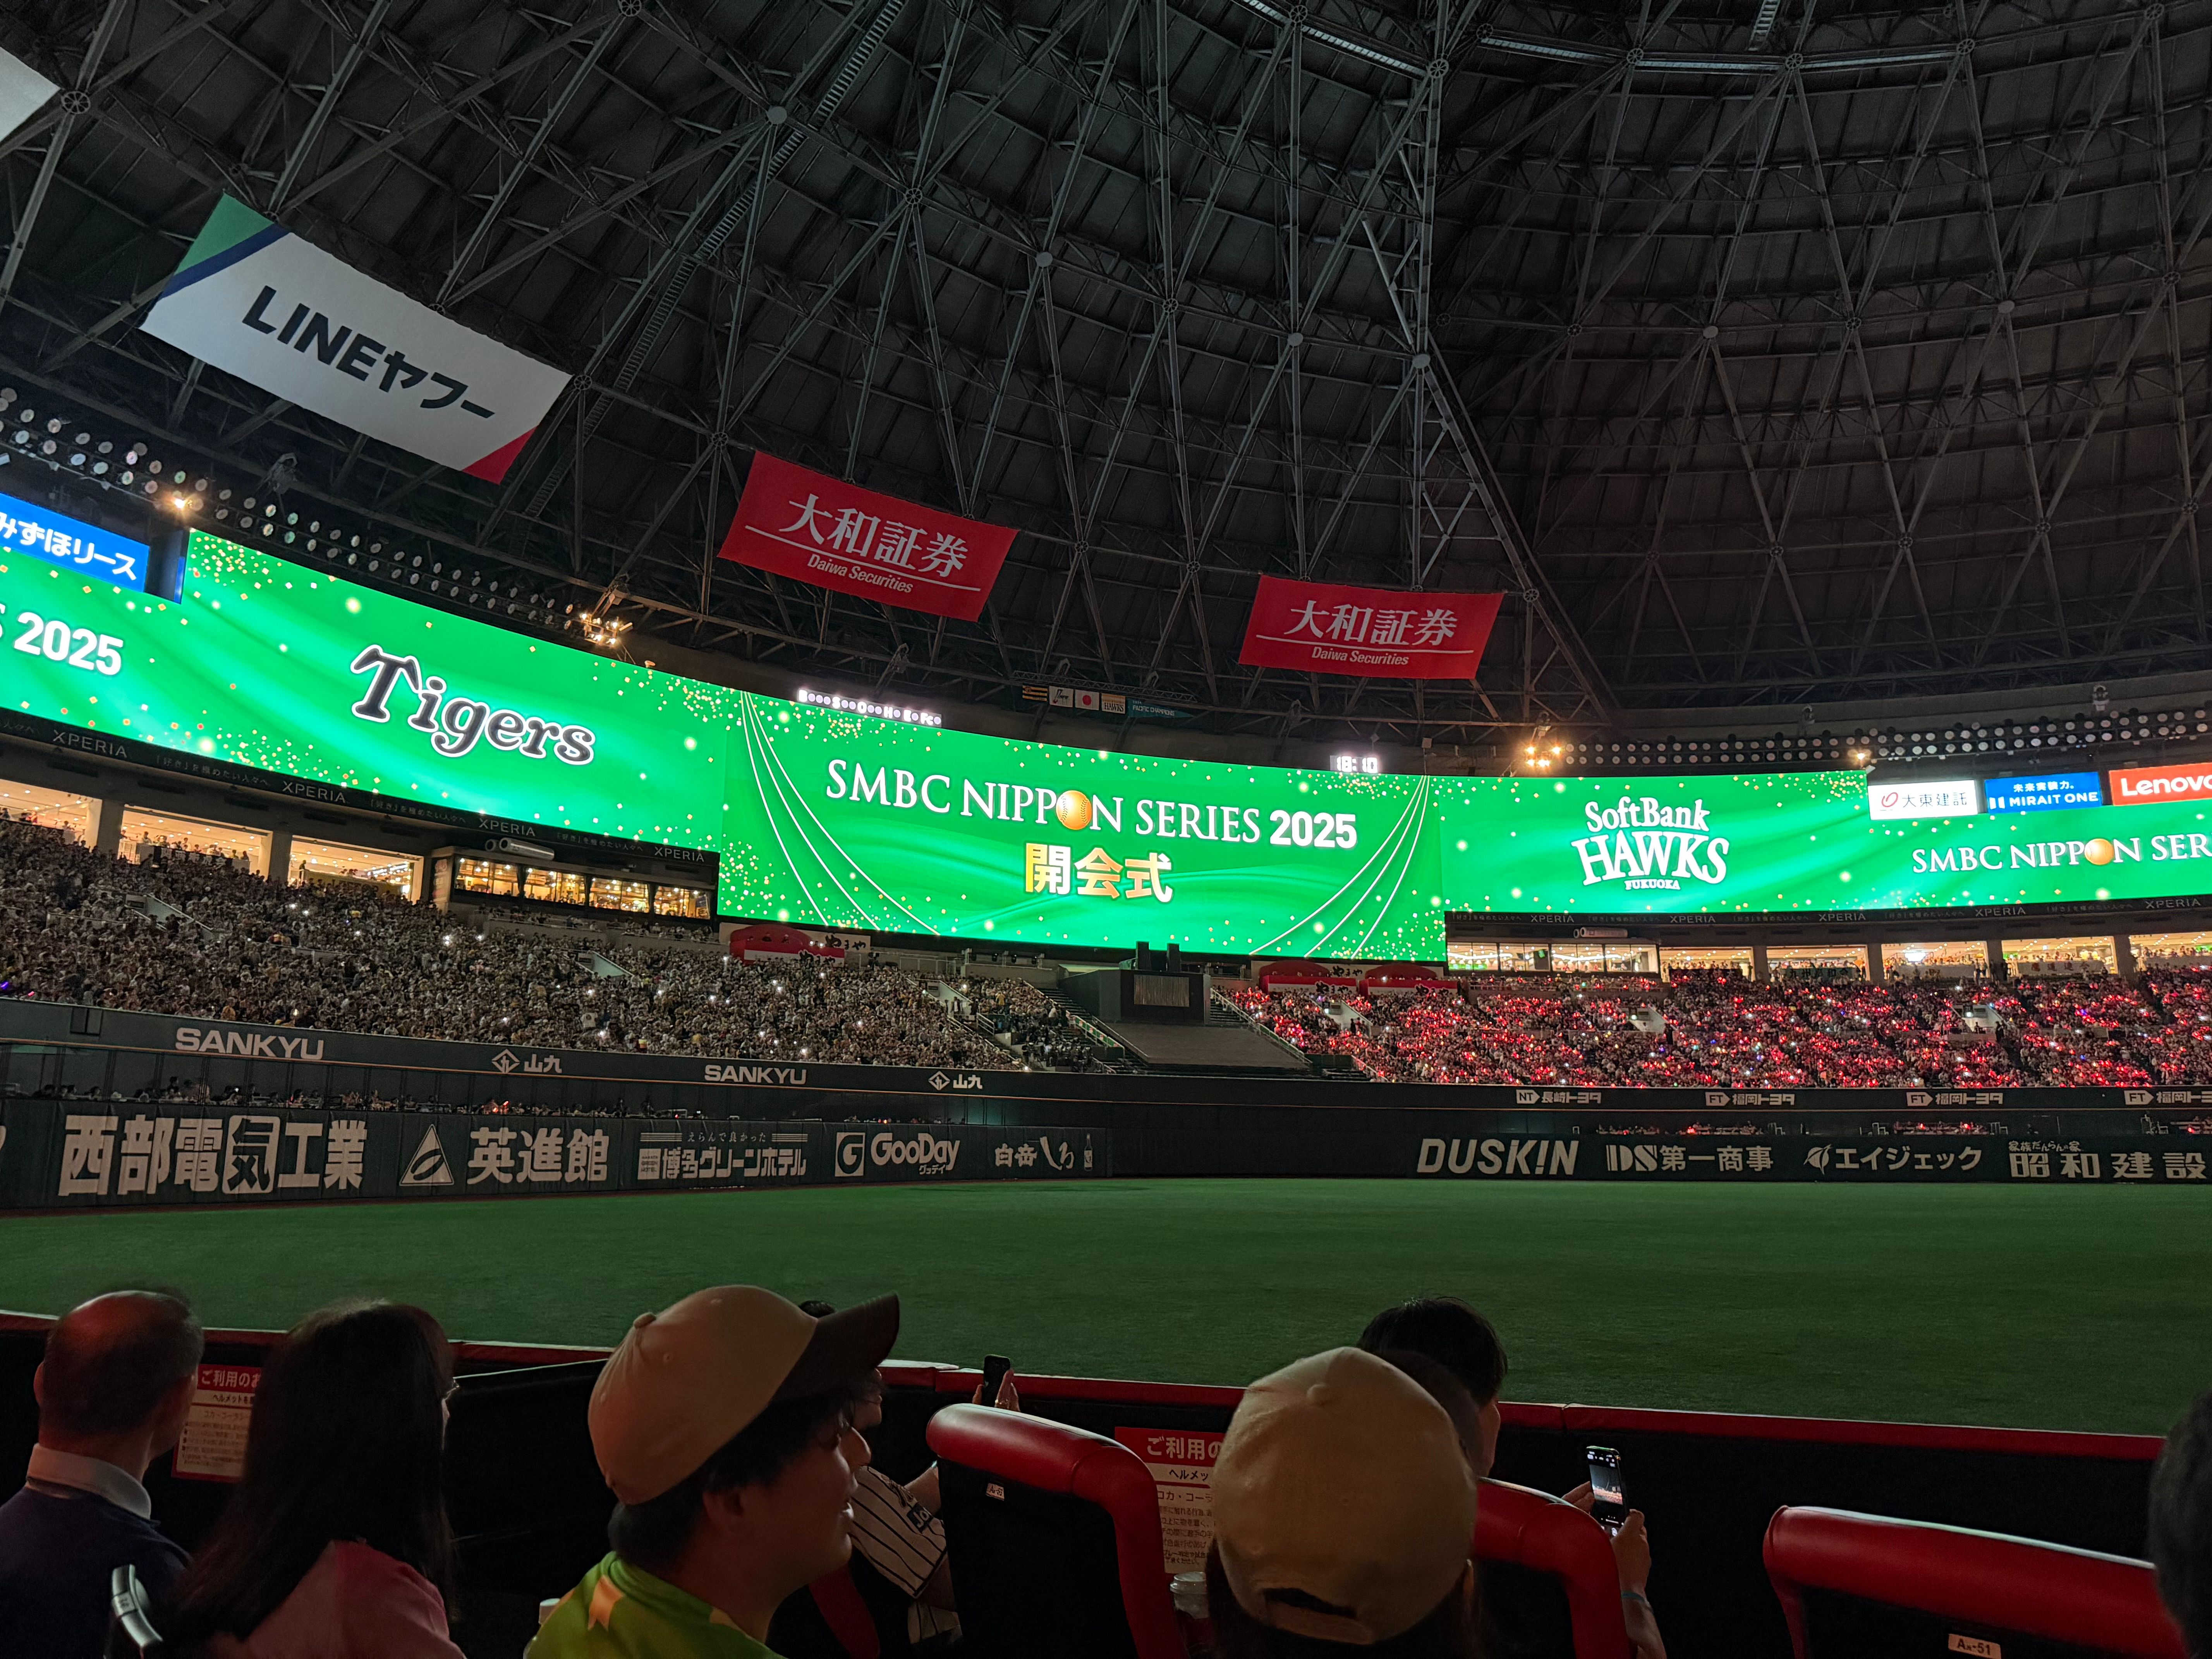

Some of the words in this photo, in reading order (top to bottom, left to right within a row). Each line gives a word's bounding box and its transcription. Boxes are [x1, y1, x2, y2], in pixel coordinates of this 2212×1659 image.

[242, 285, 495, 418] LINEヤフー
[779, 493, 969, 577] 大和証券
[0, 512, 137, 580] みずほリース
[807, 554, 848, 577] Daiwa
[848, 565, 914, 593] Securities
[1283, 599, 1458, 646] 大和証券
[14, 611, 124, 675] 2025
[1312, 646, 1348, 662] Daiwa
[1349, 651, 1410, 666] Securities
[350, 644, 596, 765] Tigers
[832, 696, 840, 709] S
[883, 706, 893, 719] H
[1104, 702, 1124, 712] HAWKS
[53, 729, 127, 759] XPERIA
[282, 780, 346, 804] XPERIA
[2013, 780, 2075, 793] 未来実装力。
[826, 759, 951, 815] SMBC
[1137, 800, 1262, 844] SERIES
[1269, 808, 1358, 850] 2025
[1902, 792, 1968, 809] 大東建託
[2009, 794, 2063, 807] MIRAIT
[2064, 792, 2099, 803] ONE
[1585, 796, 1711, 832] SoftBank
[479, 817, 536, 837] XPERIA
[654, 846, 704, 863] XPERIA
[1571, 830, 1730, 885] HAWKS
[1912, 845, 2003, 874] SMBC
[2151, 833, 2212, 861] SER
[1025, 842, 1173, 904] 開会式
[1624, 879, 1681, 890] FUKUOKA
[1975, 906, 2027, 917] XPERIA
[2145, 898, 2202, 909] XPERIA
[1530, 914, 1575, 923] XPERIA
[1669, 914, 1716, 924] XPERIA
[1819, 913, 1866, 922] XPERIA
[825, 933, 866, 950] やまや
[1330, 965, 1363, 977] やまや
[1316, 981, 1348, 994] やまや
[175, 1027, 325, 1060] SANKYU
[524, 1053, 563, 1074] 山九
[704, 1064, 808, 1085] SANKYU
[953, 1073, 983, 1089] 山九
[1541, 1091, 1602, 1103] 長崎トヨタ
[1709, 1094, 1723, 1103] FT
[1732, 1093, 1795, 1106] 福岡トヨタ
[1910, 1094, 1925, 1104] FT
[1935, 1092, 2004, 1105] 福岡トヨタ
[2128, 1093, 2145, 1103] FT
[687, 1131, 766, 1143] えらんで良かった
[57, 1114, 368, 1197] 西部電気工業
[467, 1126, 610, 1185] 英進館
[871, 1132, 961, 1171] GooDay
[1660, 1145, 1774, 1172] 第一商事
[1835, 1145, 1982, 1171] エイジェック
[662, 1146, 807, 1180] 博多グリーンホテル
[918, 1164, 946, 1176] グッデイ
[2009, 1152, 2207, 1180] 昭和建設
[1169, 1469, 1209, 1481] ヘルメッ
